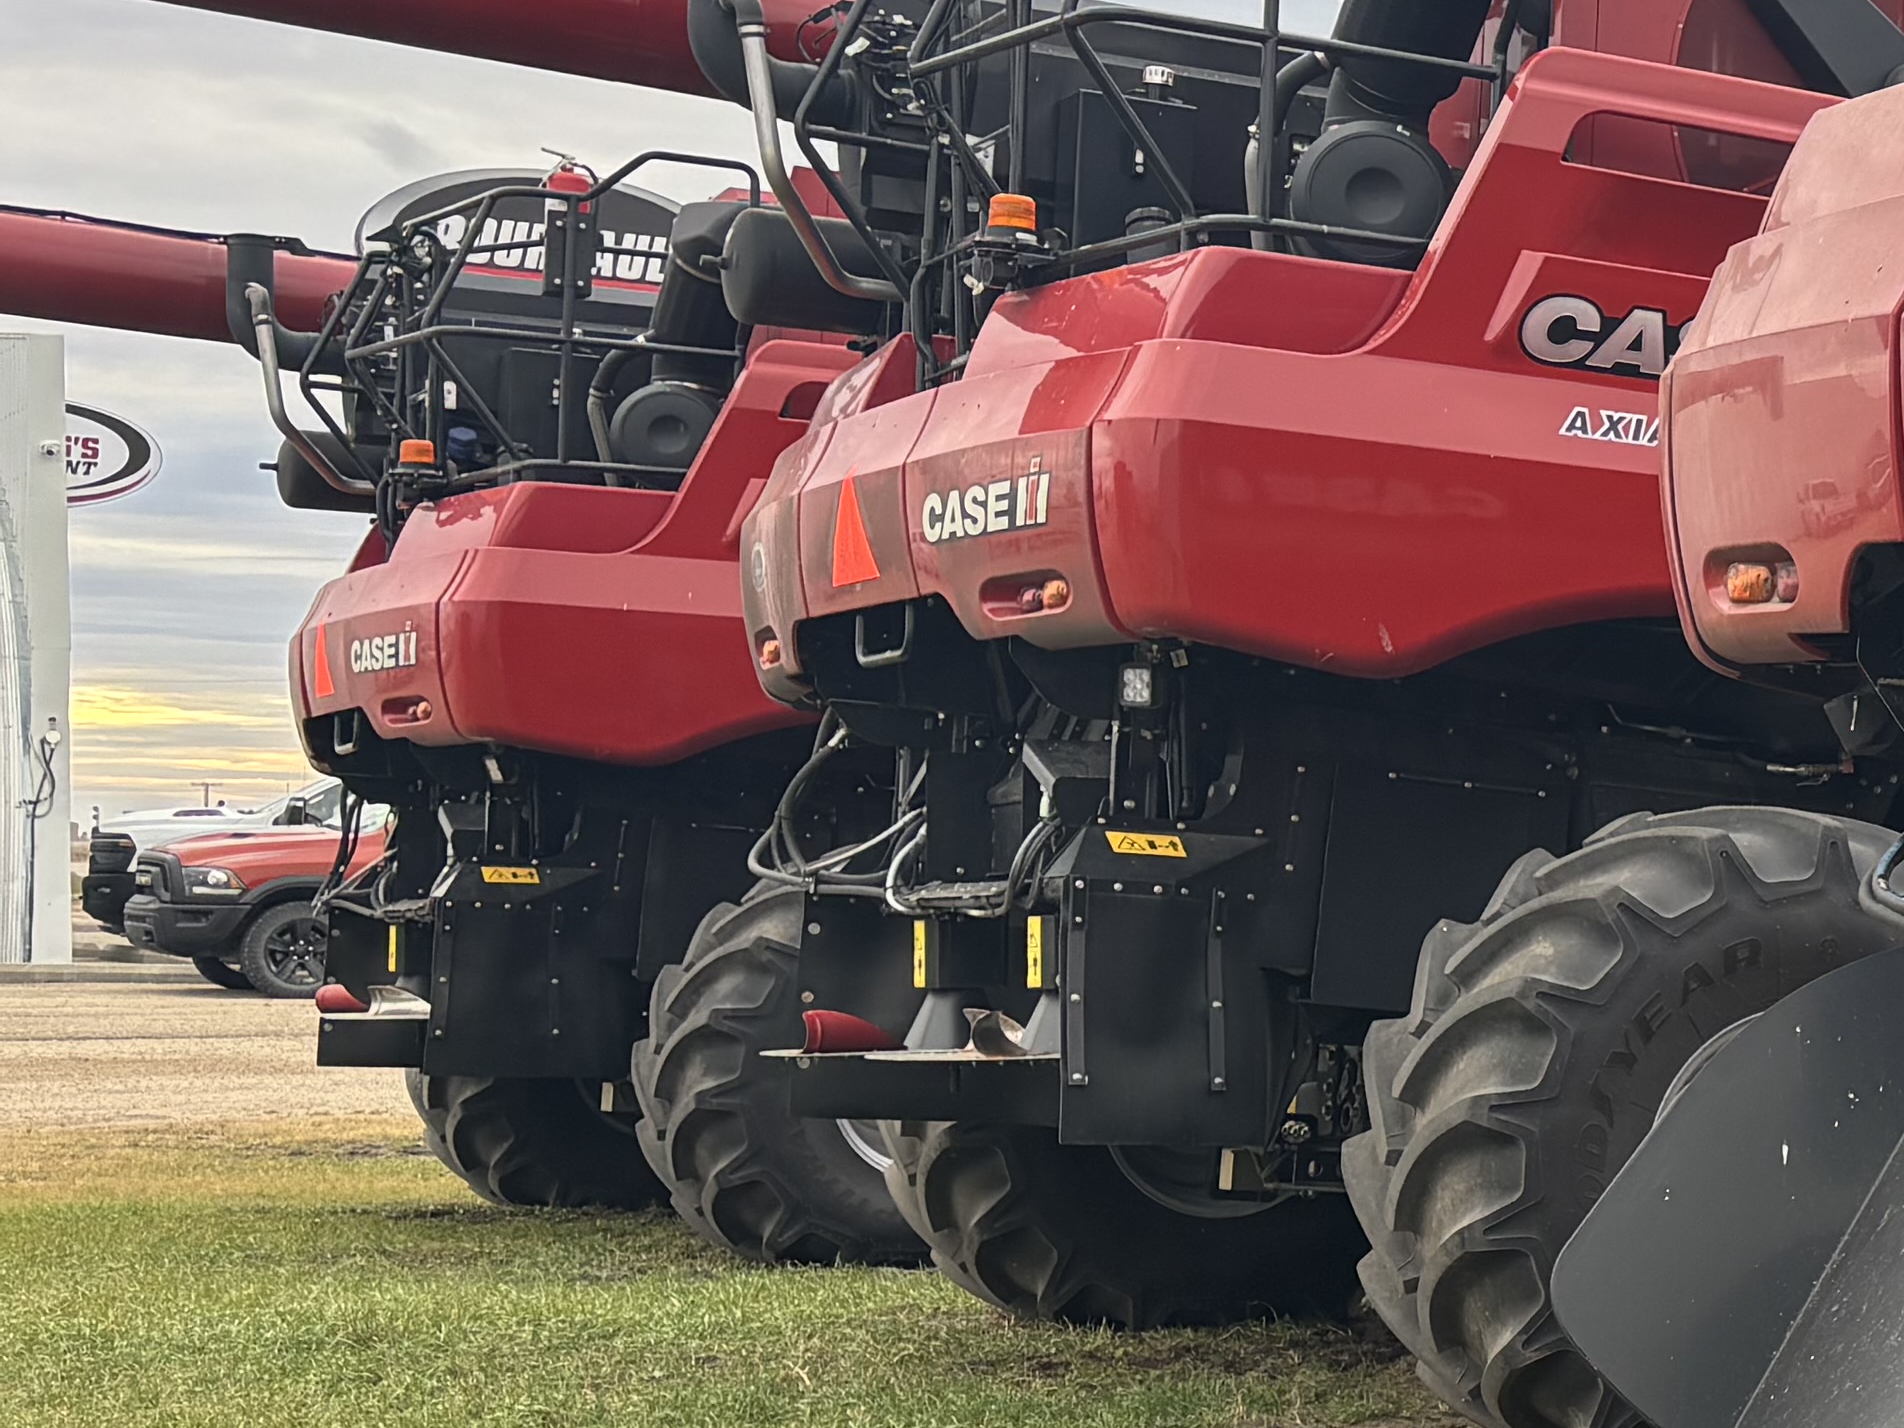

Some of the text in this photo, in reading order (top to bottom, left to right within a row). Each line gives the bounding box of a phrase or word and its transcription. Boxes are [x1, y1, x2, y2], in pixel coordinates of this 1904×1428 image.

[1520, 295, 1694, 376] CA
[921, 479, 1012, 544] CASE
[350, 634, 397, 674] CASE
